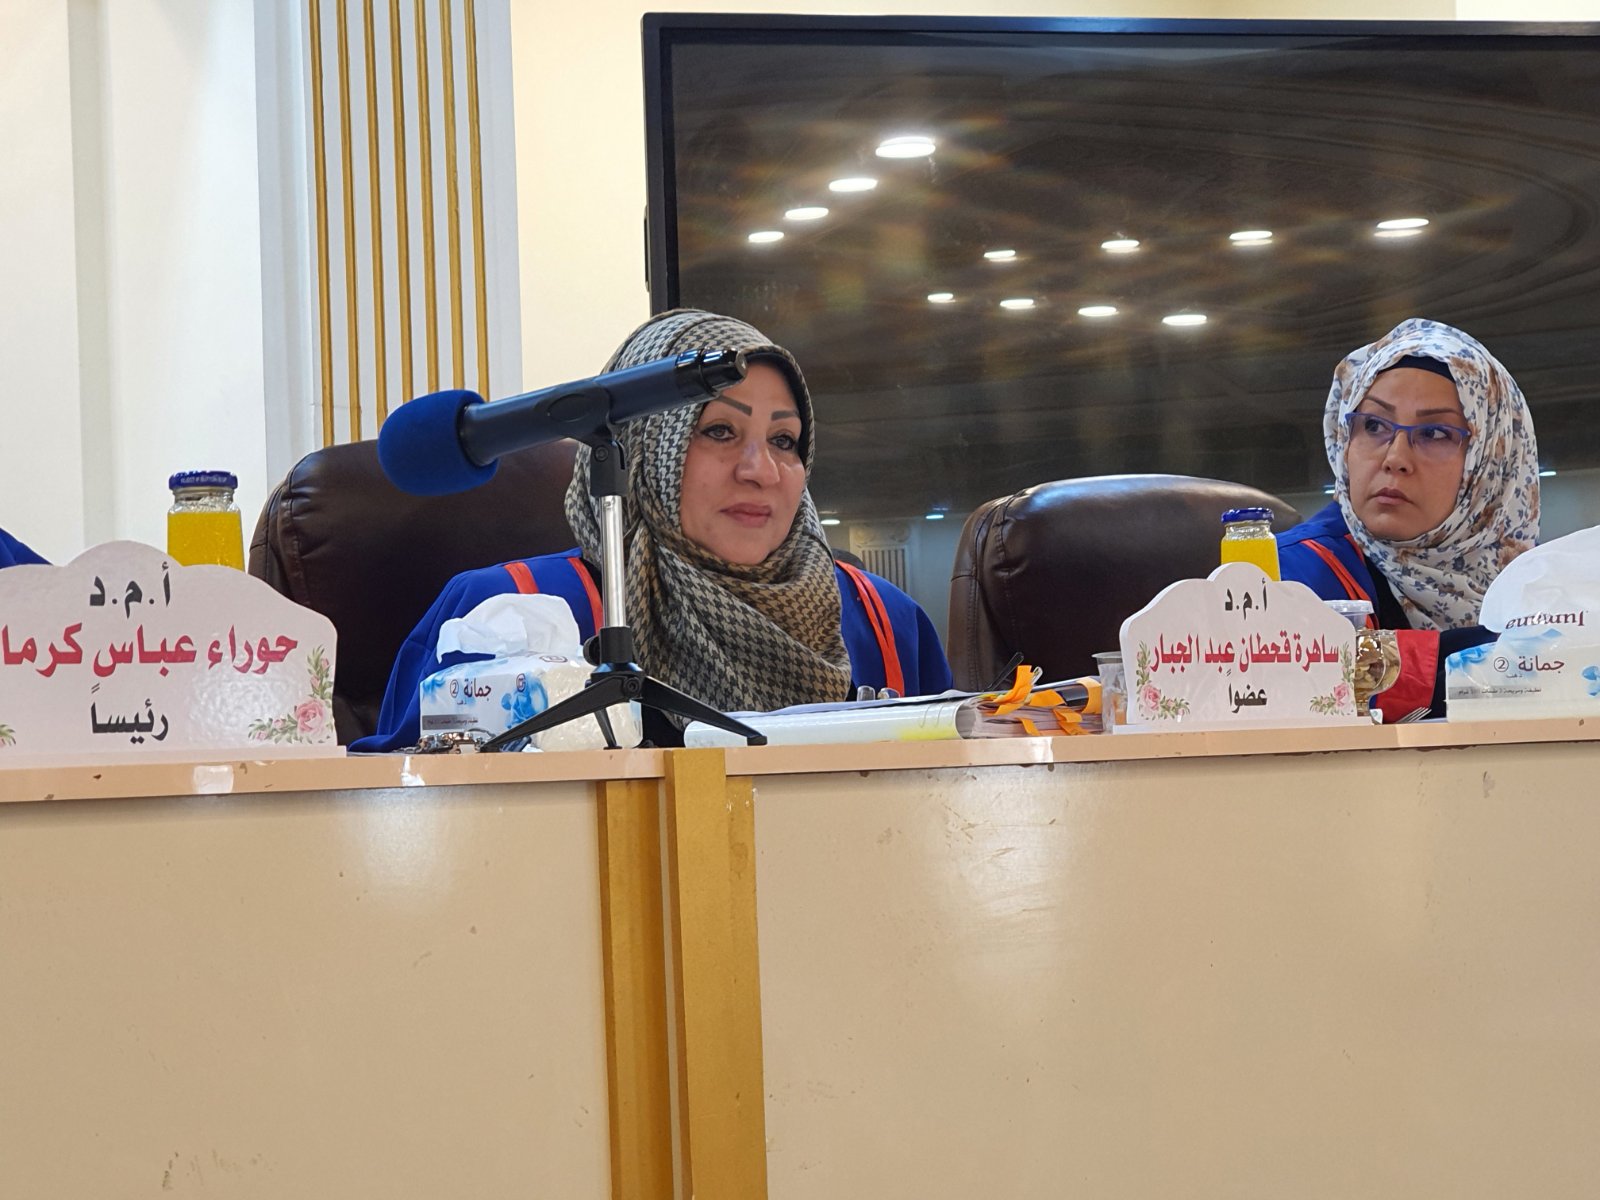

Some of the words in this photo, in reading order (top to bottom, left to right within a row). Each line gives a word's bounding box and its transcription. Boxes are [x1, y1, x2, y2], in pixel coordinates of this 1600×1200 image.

[89, 561, 171, 620] أ.م.د
[1224, 577, 1268, 620] أ.م.د
[93, 624, 197, 677] عباس
[206, 624, 298, 675] حوراء
[1150, 632, 1200, 675] الجبار
[1204, 636, 1235, 673] عبد
[1239, 629, 1292, 673] قحطان
[1294, 631, 1339, 673] ساهرة
[1518, 655, 1565, 674] جمانة
[463, 677, 492, 702] جمانة
